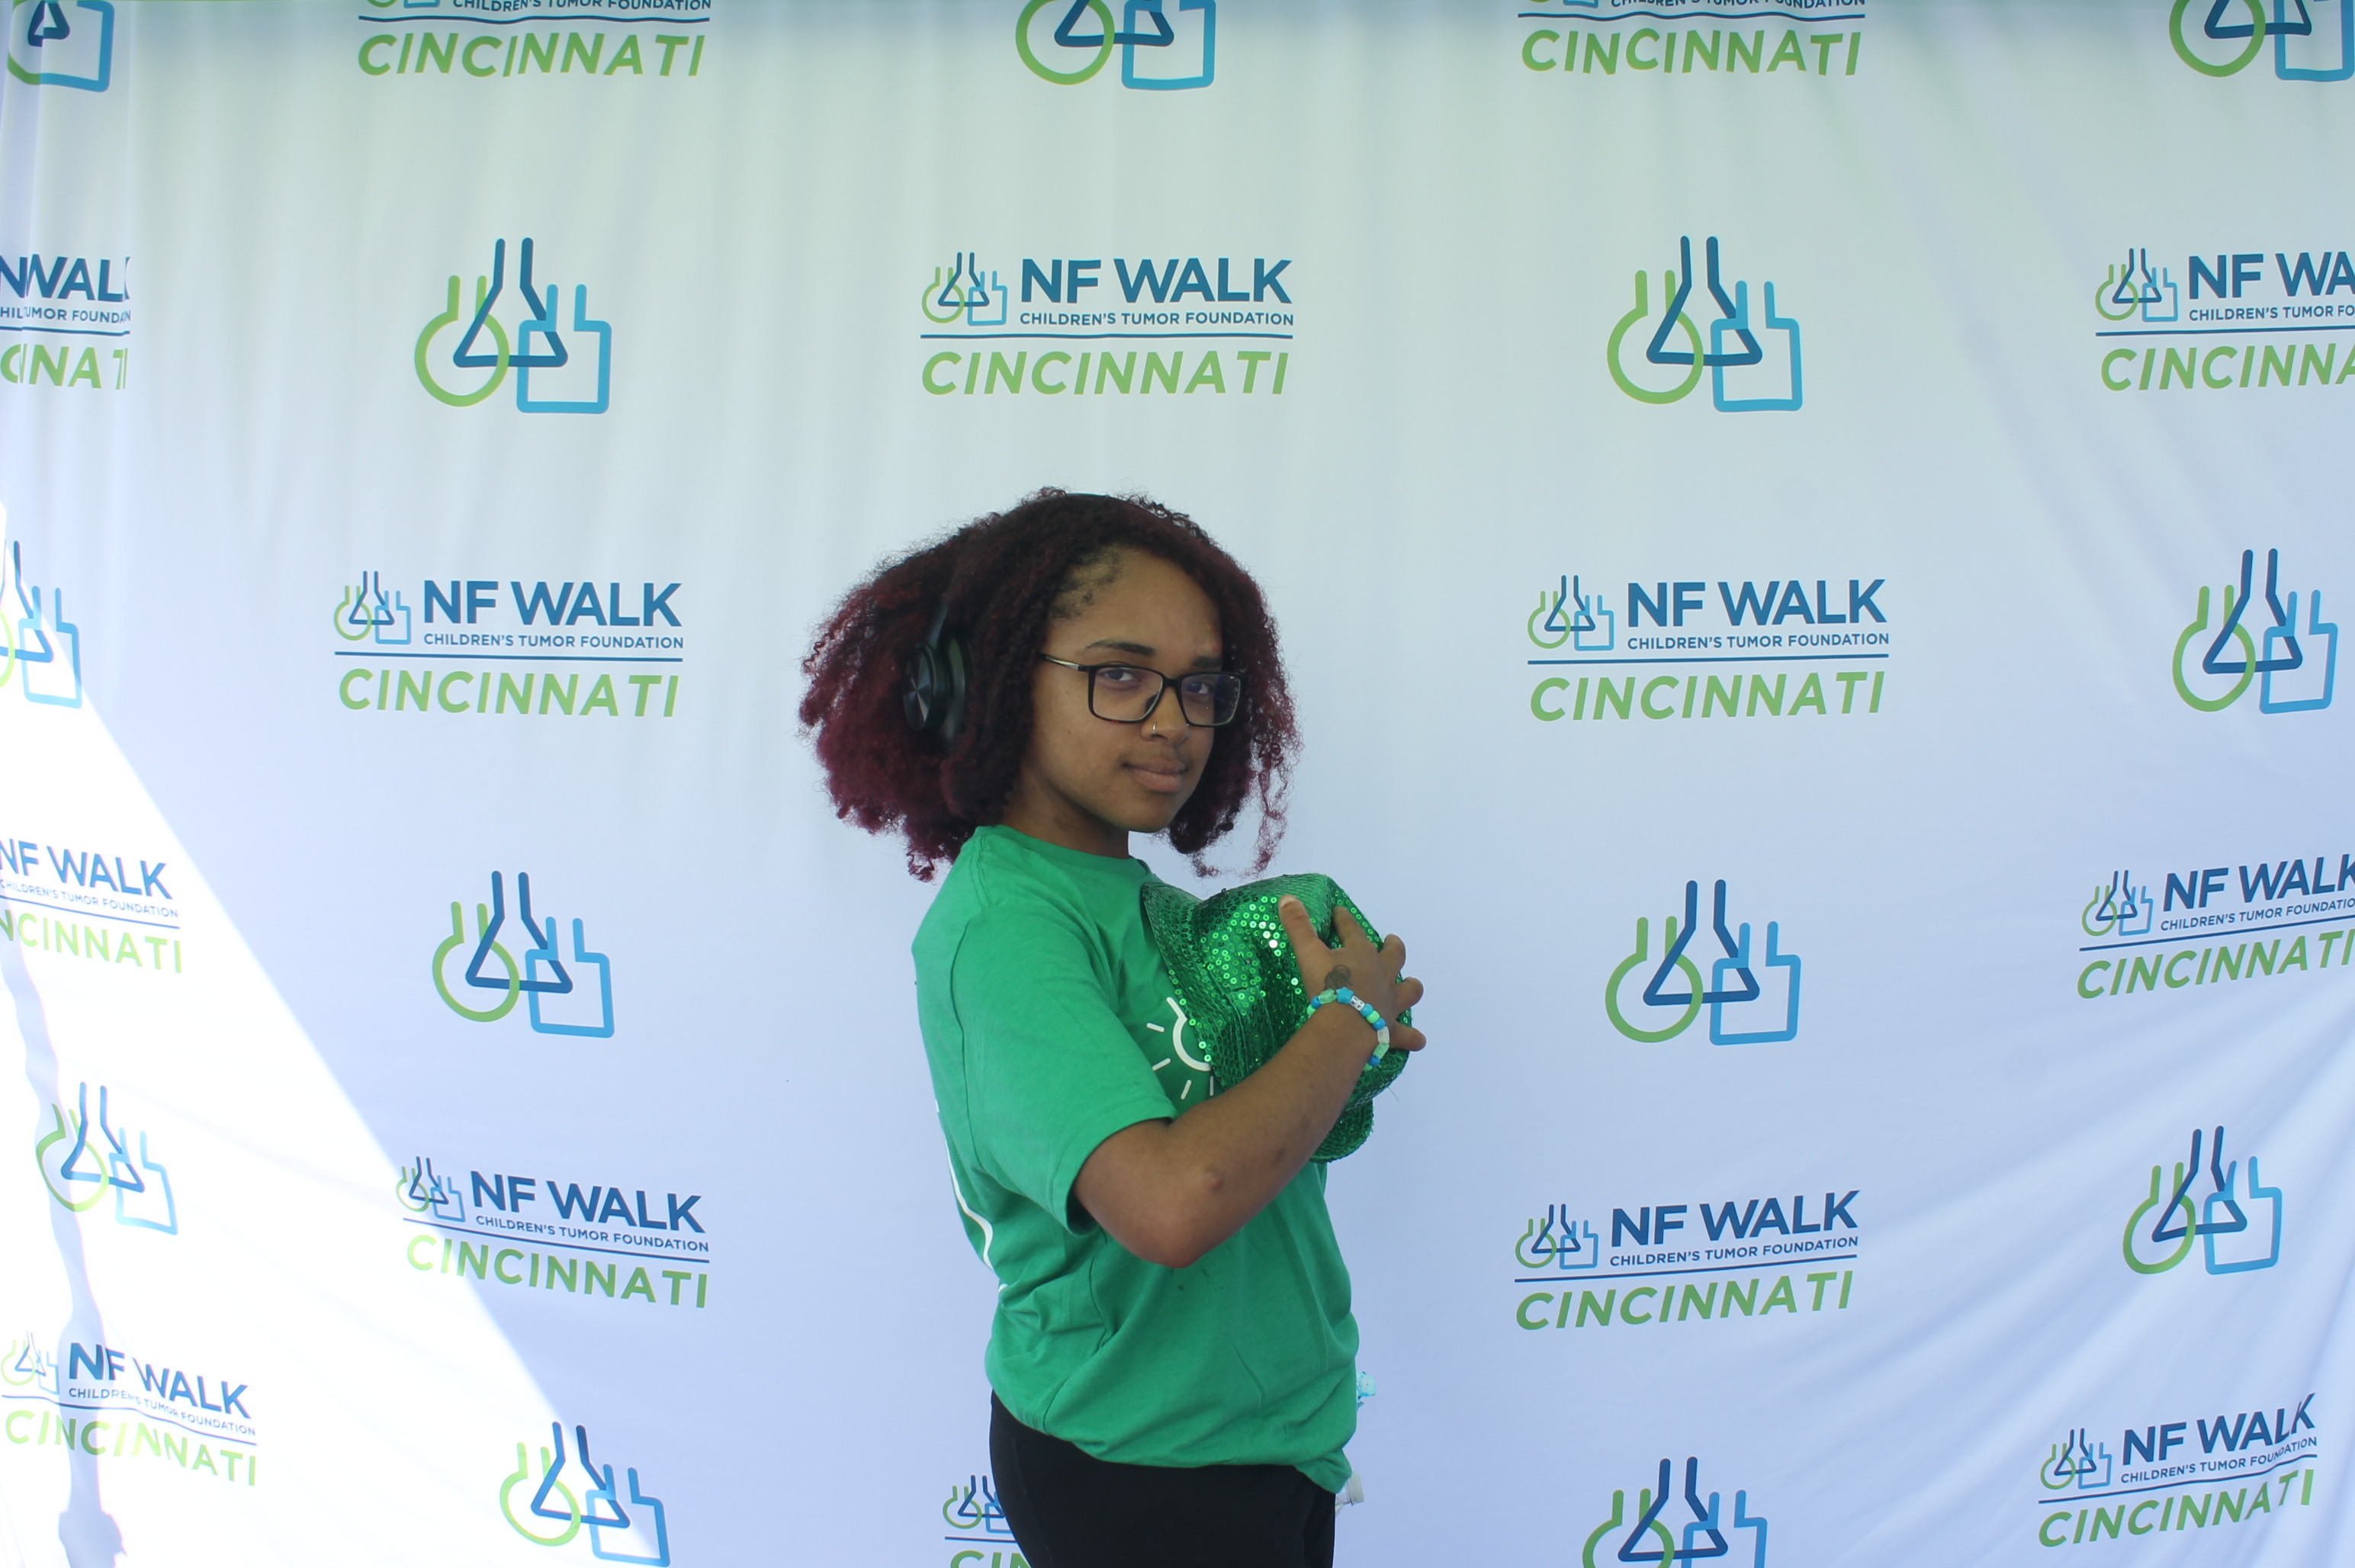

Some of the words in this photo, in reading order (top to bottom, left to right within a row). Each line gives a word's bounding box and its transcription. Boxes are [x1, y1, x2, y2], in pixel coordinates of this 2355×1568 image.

[358, 32, 705, 77] CINCINNATI
[1521, 28, 1862, 76] CINCINNATI
[1020, 259, 1101, 304] NF
[1113, 258, 1293, 304] WALK
[2189, 253, 2263, 300] NF
[1020, 312, 1116, 326] CHILDREN'S
[1121, 313, 1180, 325] TUMOR
[1185, 313, 1294, 326] FOUNDATION
[2189, 307, 2278, 321] CHILDREN'S
[2283, 305, 2334, 319] TUMOR
[921, 351, 1289, 395] CINCINNATI
[423, 580, 499, 625] NF
[510, 581, 683, 627] WALK
[1627, 581, 1706, 628] NF
[1717, 579, 1888, 627] WALK
[423, 633, 514, 647] CHILDREN'S
[519, 635, 576, 648] TUMOR
[580, 635, 684, 649] FOUNDATION
[1627, 635, 1722, 651] CHILDREN'S
[1727, 635, 1782, 649] TUMOR
[1788, 632, 1890, 647] FOUNDATION
[339, 668, 679, 718] CINCINNATI
[1530, 671, 1885, 722] CINCINNATI
[46, 845, 173, 900] WALK
[2163, 867, 2229, 912] NF
[0, 879, 59, 899] CHILDREN'S
[61, 891, 99, 907] TUMOR
[103, 898, 178, 919] FOUNDATION
[2161, 912, 2235, 931] CHILDREN'S
[2239, 907, 2283, 923] TUMOR
[2077, 928, 2355, 999] CINCINNATI
[470, 1170, 535, 1213] NF
[546, 1180, 706, 1234] WALK
[1611, 1204, 1687, 1247] NF
[1699, 1190, 1861, 1242] WALK
[476, 1215, 556, 1235] CHILDREN'S
[559, 1226, 609, 1242] TUMOR
[613, 1233, 709, 1252] FOUNDATION
[1609, 1251, 1701, 1267] CHILDREN'S
[1704, 1245, 1758, 1261] TUMOR
[1762, 1235, 1859, 1256] FOUNDATION
[406, 1234, 708, 1309] CINCINNATI
[1516, 1270, 1853, 1331] CINCINNATI
[69, 1342, 125, 1381] NF
[132, 1356, 252, 1419] WALK
[69, 1388, 142, 1406] CHILDREN'S
[144, 1399, 178, 1419] TUMOR
[182, 1412, 256, 1437] FOUNDATION
[2122, 1422, 2186, 1466] NF
[2196, 1392, 2315, 1454] WALK
[5, 1410, 256, 1486] CINCINNATI
[2121, 1463, 2196, 1483] CHILDREN'S
[2199, 1457, 2246, 1472] TUMOR
[2250, 1436, 2317, 1466] FOUNDATION
[2039, 1469, 2315, 1547] CINCINNATI
